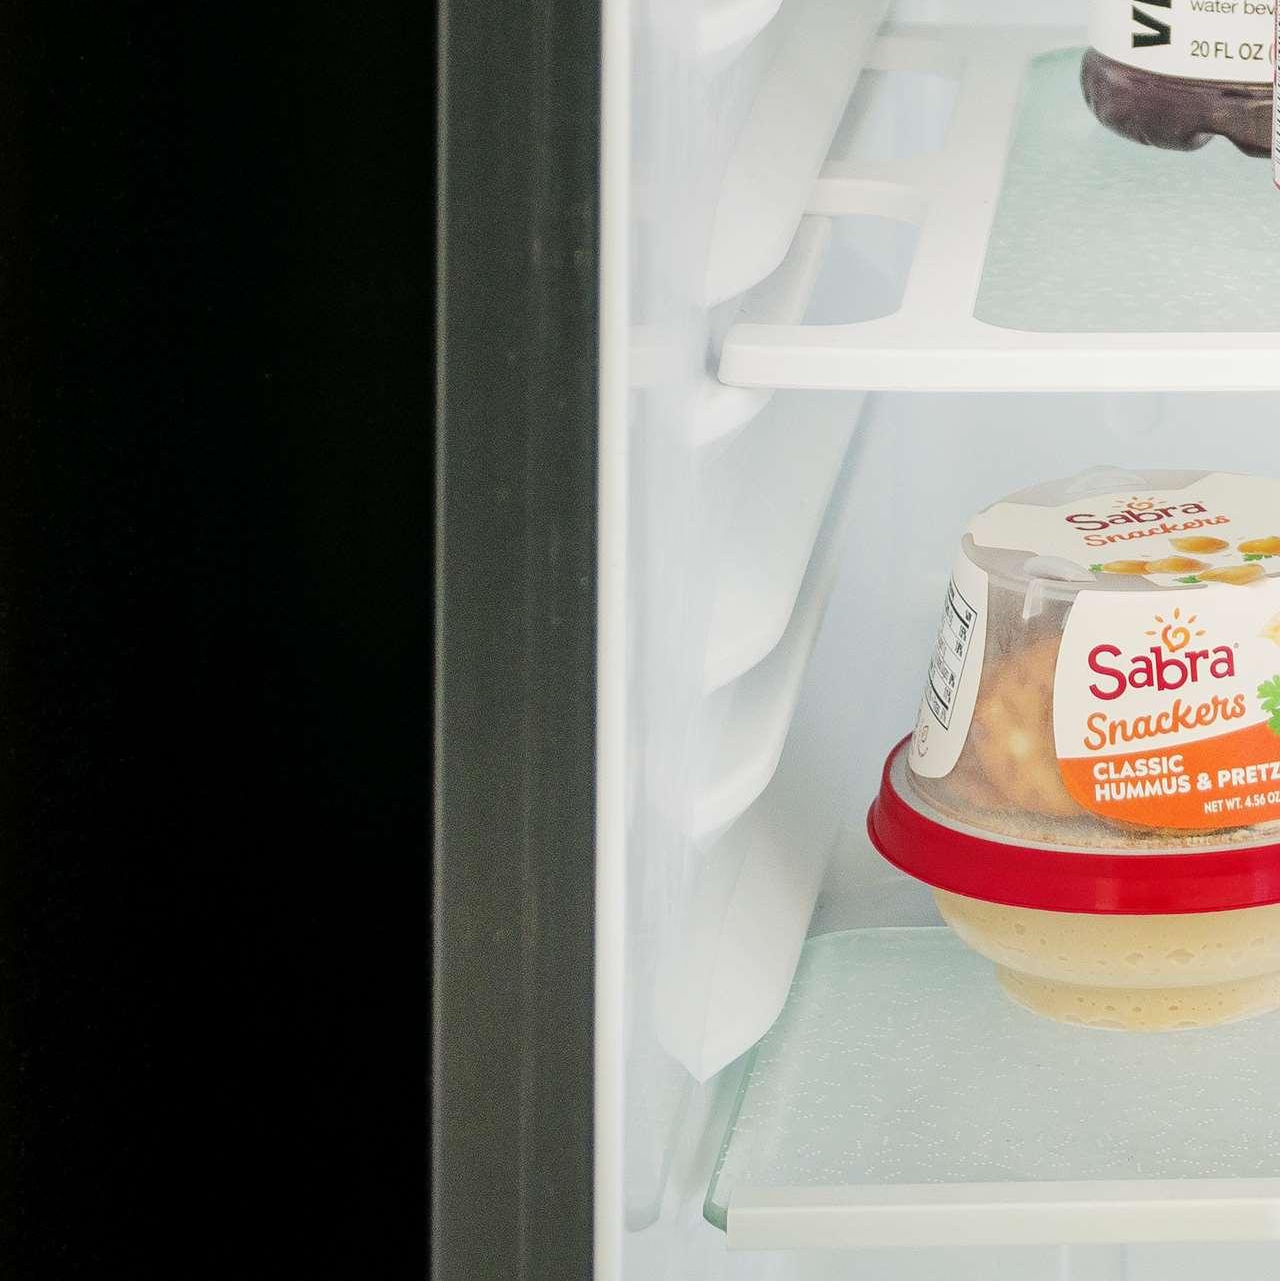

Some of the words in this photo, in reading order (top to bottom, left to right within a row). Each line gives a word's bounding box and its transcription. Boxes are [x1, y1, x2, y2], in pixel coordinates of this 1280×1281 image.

[1190, 0, 1236, 16] water
[1191, 40, 1210, 58] 20
[1214, 42, 1233, 60] FL
[1239, 43, 1264, 61] OZ
[1065, 499, 1208, 533] Sabra
[1083, 514, 1231, 548] Snackers
[1087, 642, 1235, 701] Sabra
[1083, 692, 1247, 752] Snackers
[1092, 754, 1184, 781] CLASSIC
[1094, 772, 1191, 802] HUMMUS
[1196, 771, 1213, 790] &
[1204, 799, 1224, 815] NET
[1225, 796, 1244, 813] WT.
[1245, 792, 1266, 810] 4.56
[1267, 791, 1280, 807] OZ
